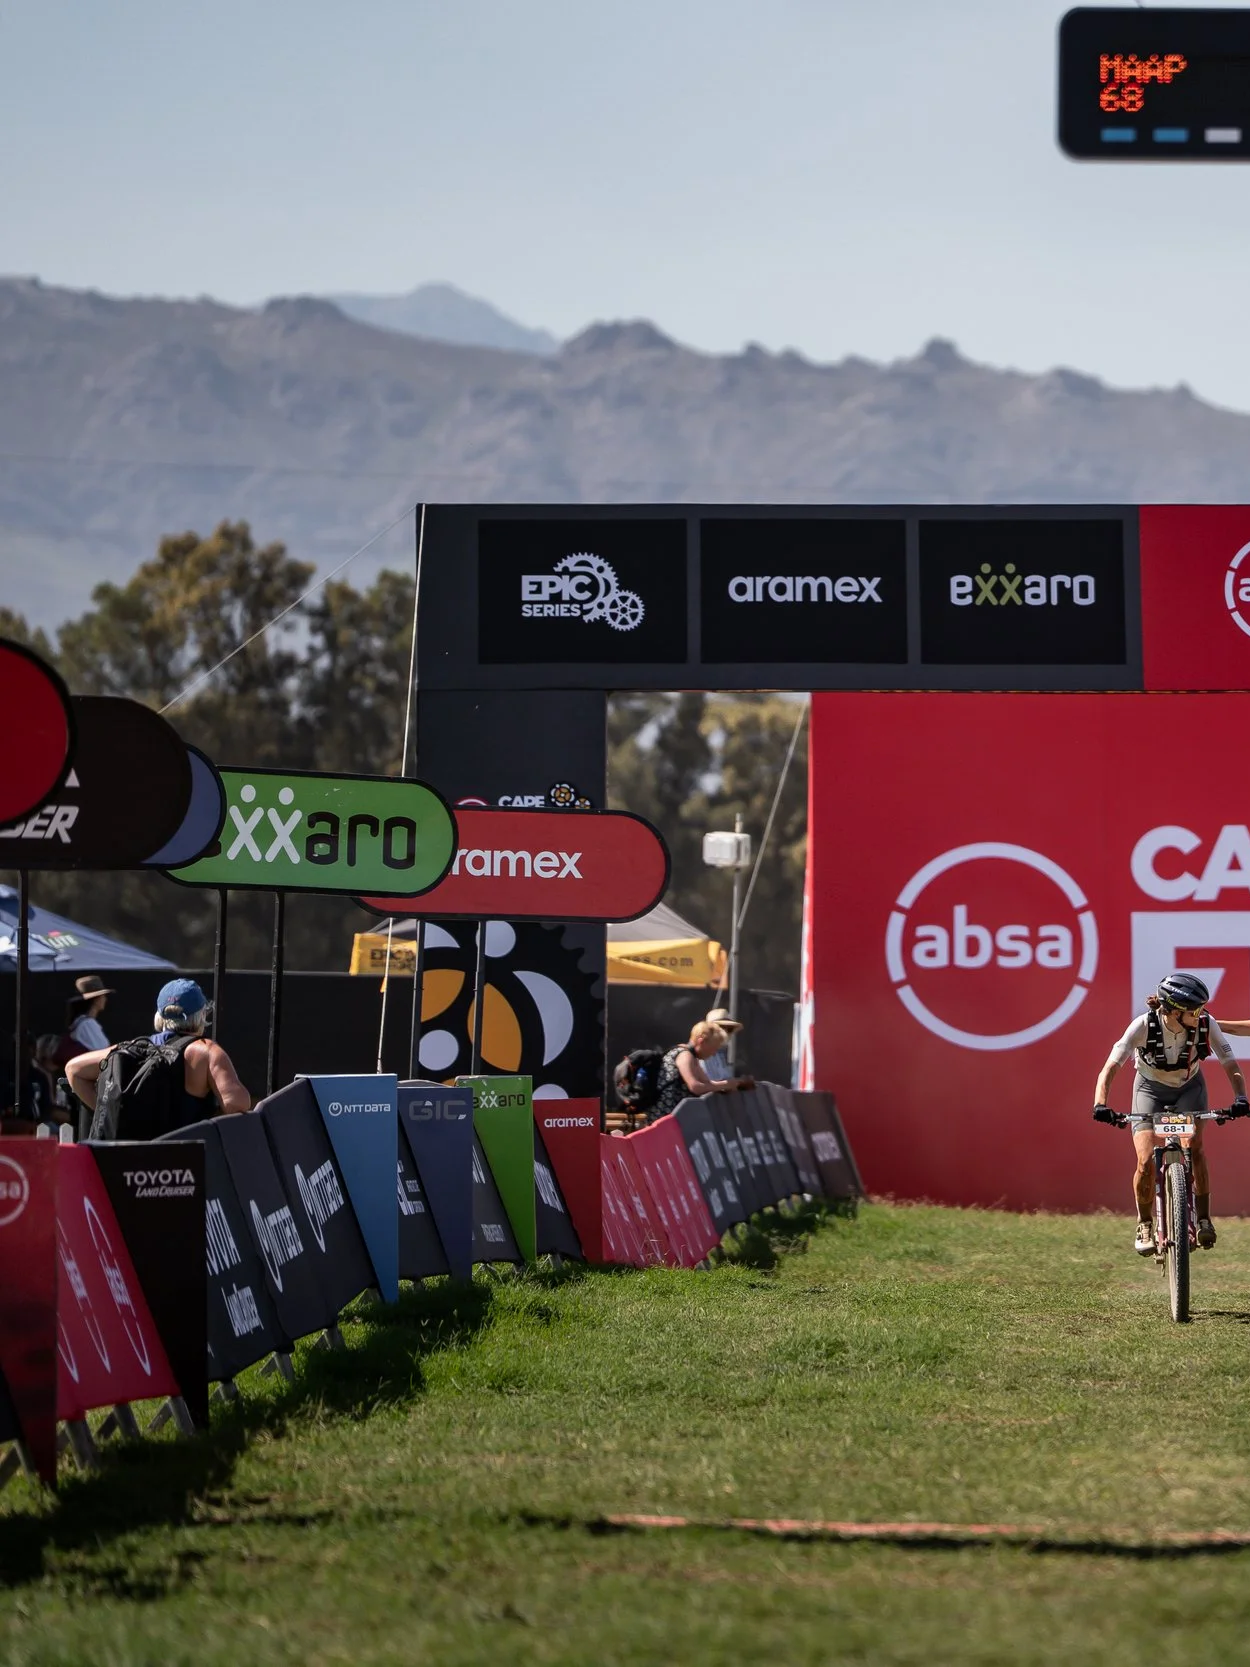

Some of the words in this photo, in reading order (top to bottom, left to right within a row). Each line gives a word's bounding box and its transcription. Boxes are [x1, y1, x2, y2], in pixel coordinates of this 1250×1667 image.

[1100, 54, 1188, 83] MAAP
[1100, 83, 1145, 112] 68
[521, 575, 592, 601] EPIC
[728, 572, 882, 603] aramex
[949, 563, 1096, 606] exxaro
[521, 604, 582, 617] SERIES
[200, 784, 417, 870] xxaro
[911, 904, 1075, 970] absa
[344, 1104, 364, 1113] NTT
[409, 1100, 468, 1121] GIC
[544, 1117, 594, 1128] aramex
[123, 1169, 195, 1187] TOYOTA
